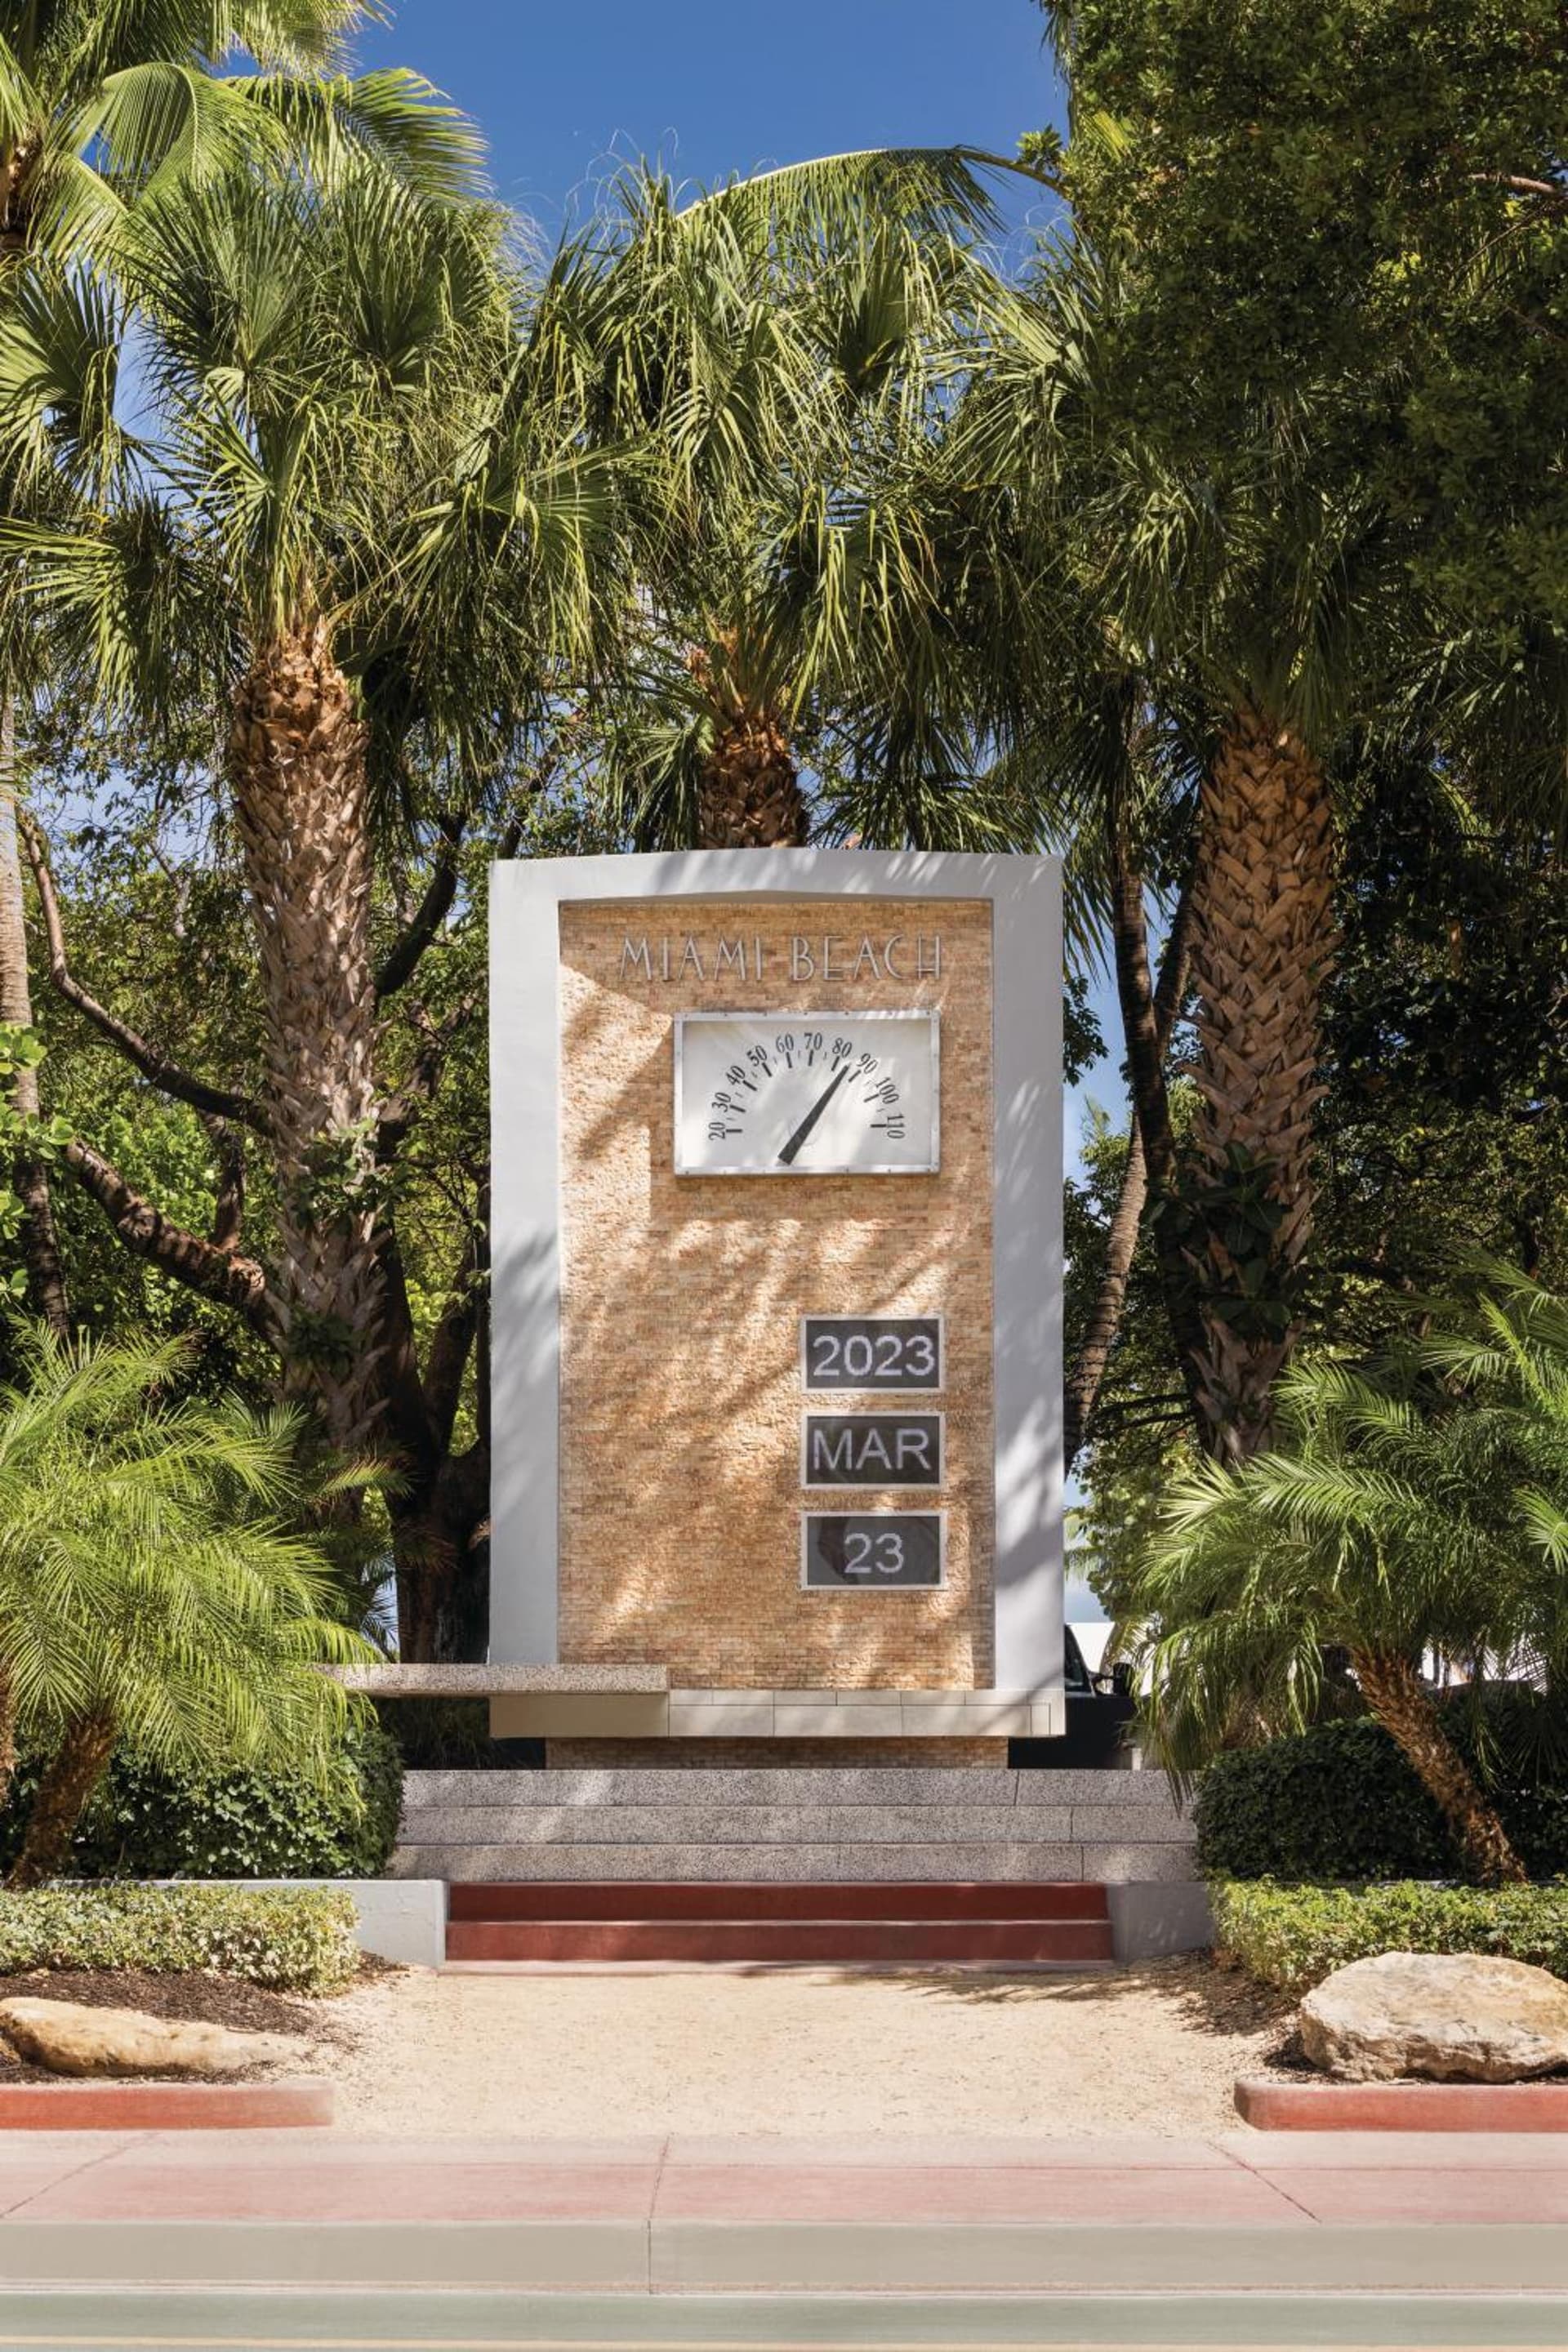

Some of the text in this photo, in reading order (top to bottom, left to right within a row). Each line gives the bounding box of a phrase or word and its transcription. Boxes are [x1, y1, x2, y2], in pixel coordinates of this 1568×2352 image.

[621, 933, 941, 981] MIAMI BEACH
[708, 1032, 906, 1140] 20 30 40 50 60 70 80 90 100 110
[813, 1335, 935, 1376] 2023
[813, 1428, 931, 1470] MAR
[844, 1533, 905, 1574] 23
